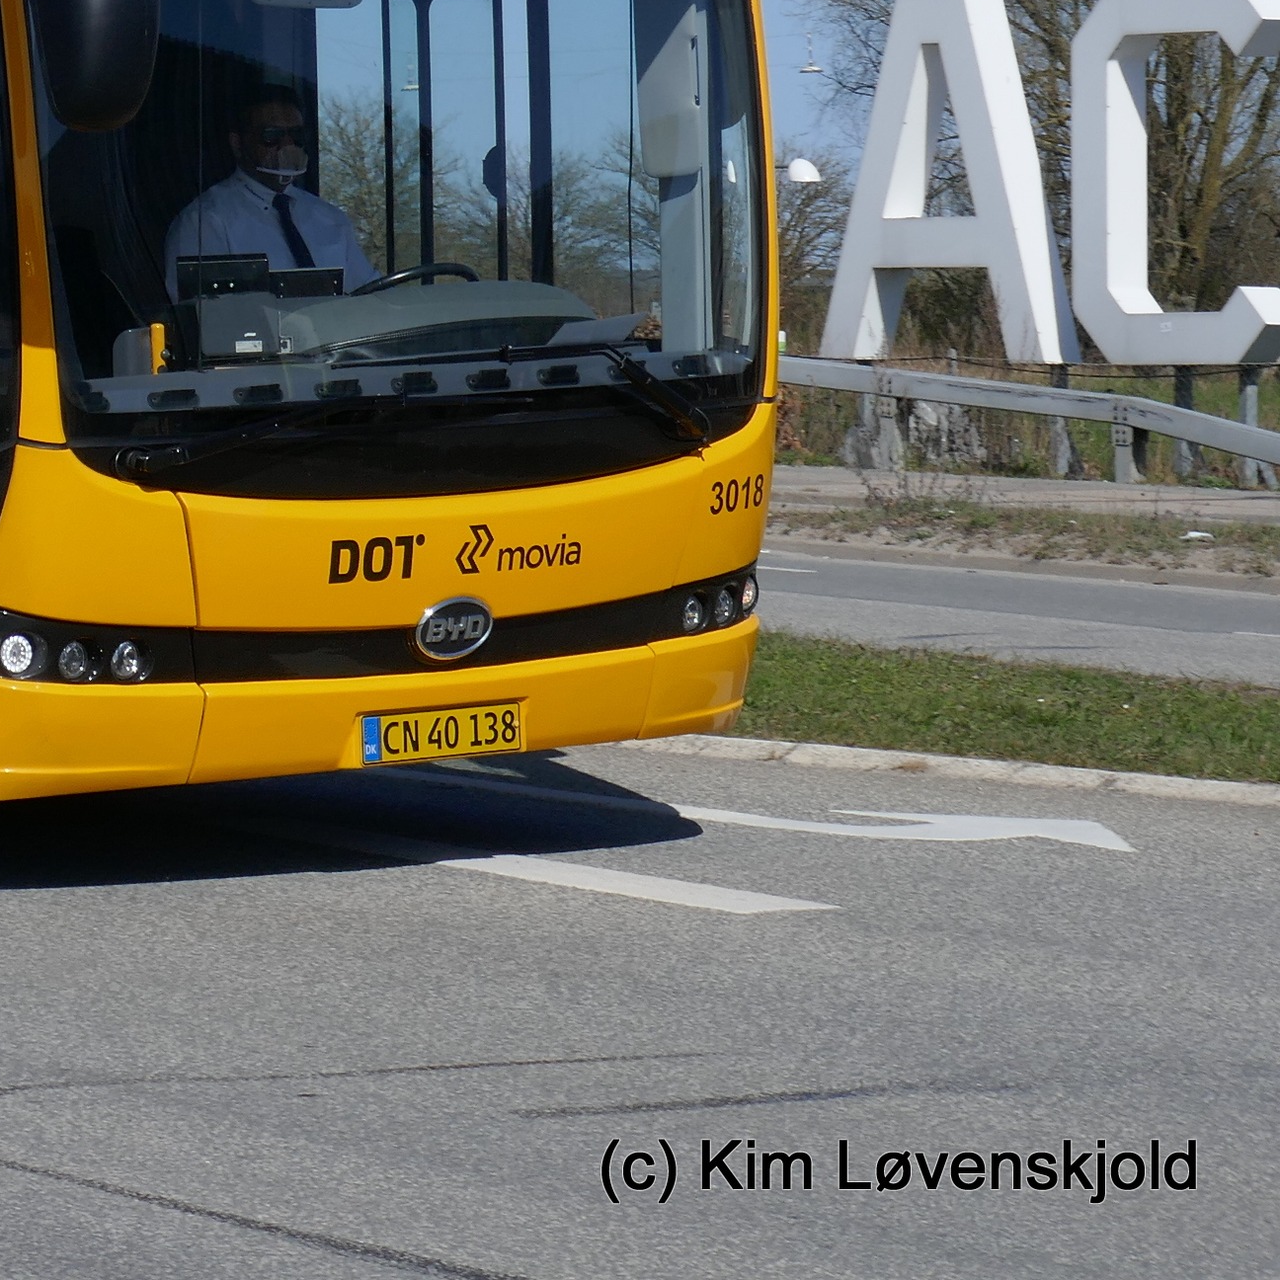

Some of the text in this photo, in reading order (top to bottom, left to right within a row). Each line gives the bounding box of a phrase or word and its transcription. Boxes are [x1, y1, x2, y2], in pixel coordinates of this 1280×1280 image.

[709, 473, 764, 516] 3018
[328, 533, 582, 585] DOT movia
[425, 613, 484, 643] BYD
[365, 709, 516, 755] DK CN 40 138
